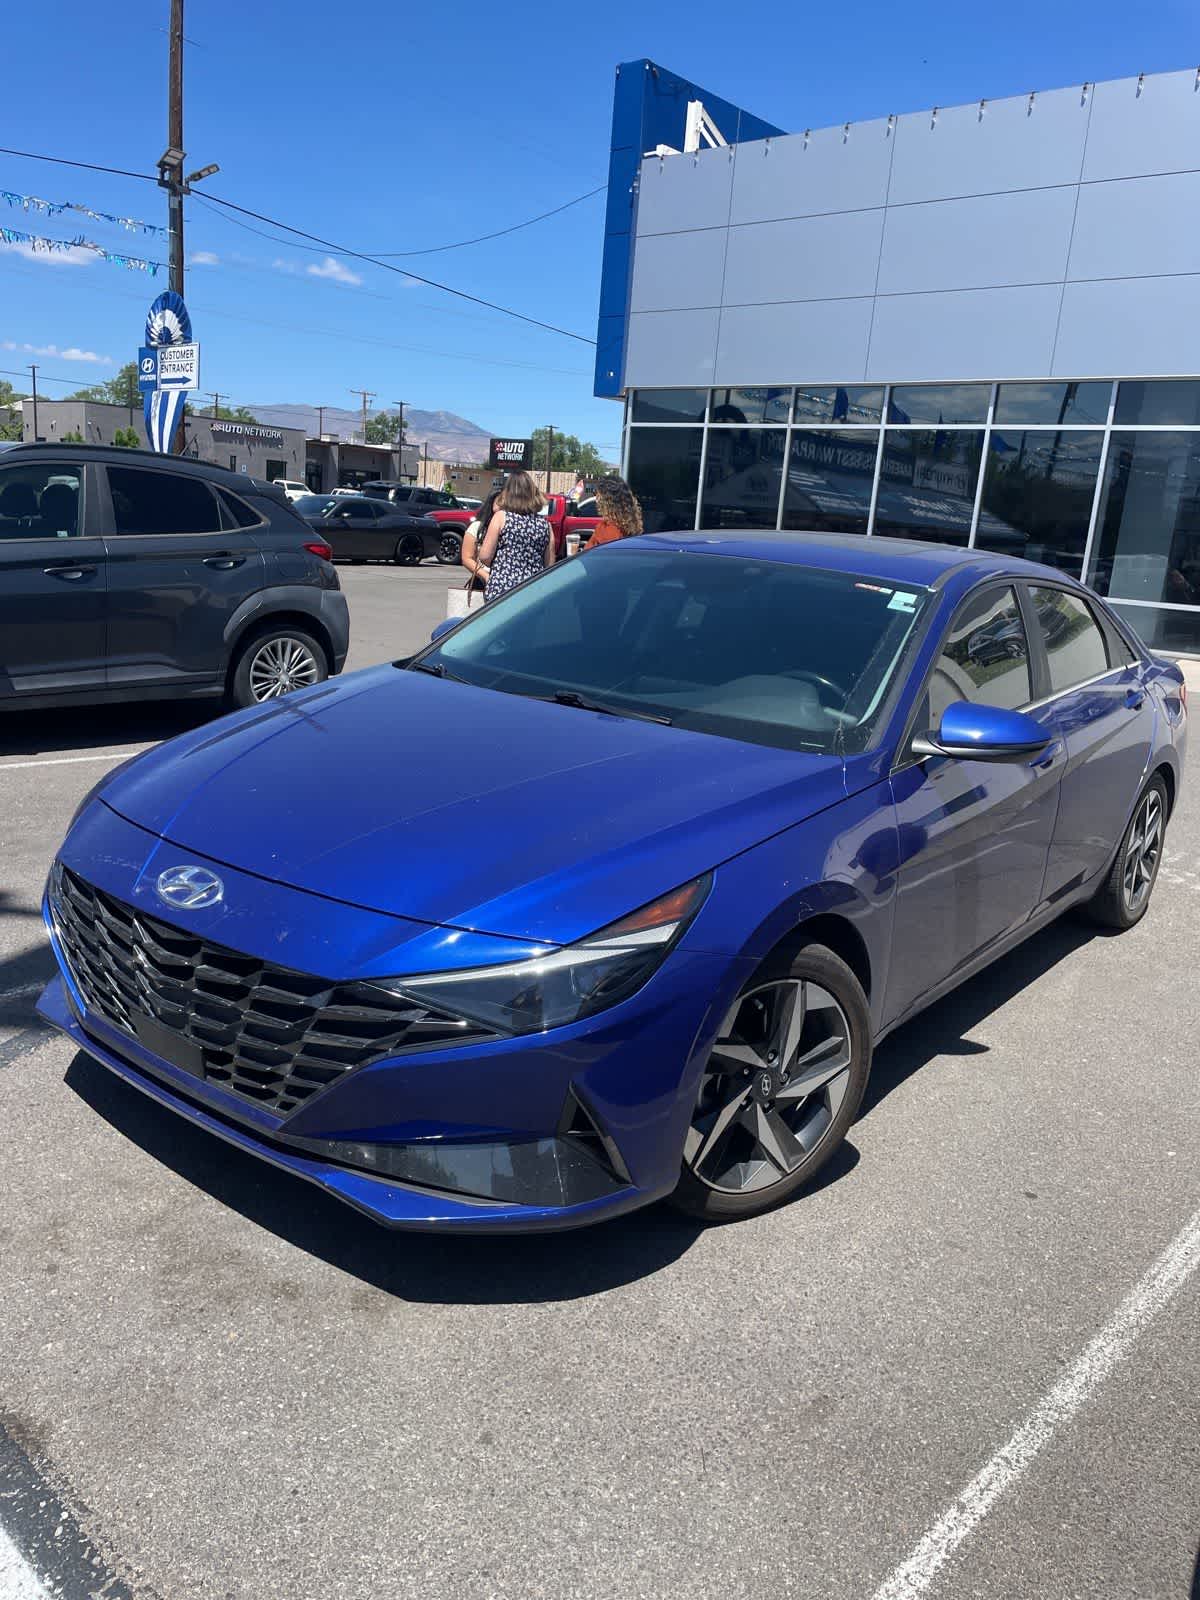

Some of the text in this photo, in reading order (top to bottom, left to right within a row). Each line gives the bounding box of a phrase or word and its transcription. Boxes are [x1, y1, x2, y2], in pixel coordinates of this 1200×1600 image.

[160, 349, 194, 360] CUSTOMER
[160, 363, 193, 373] ENTRANCE
[211, 423, 282, 438] AUTO NETWORK
[496, 442, 525, 453] AUTO
[497, 453, 523, 461] NETWORK
